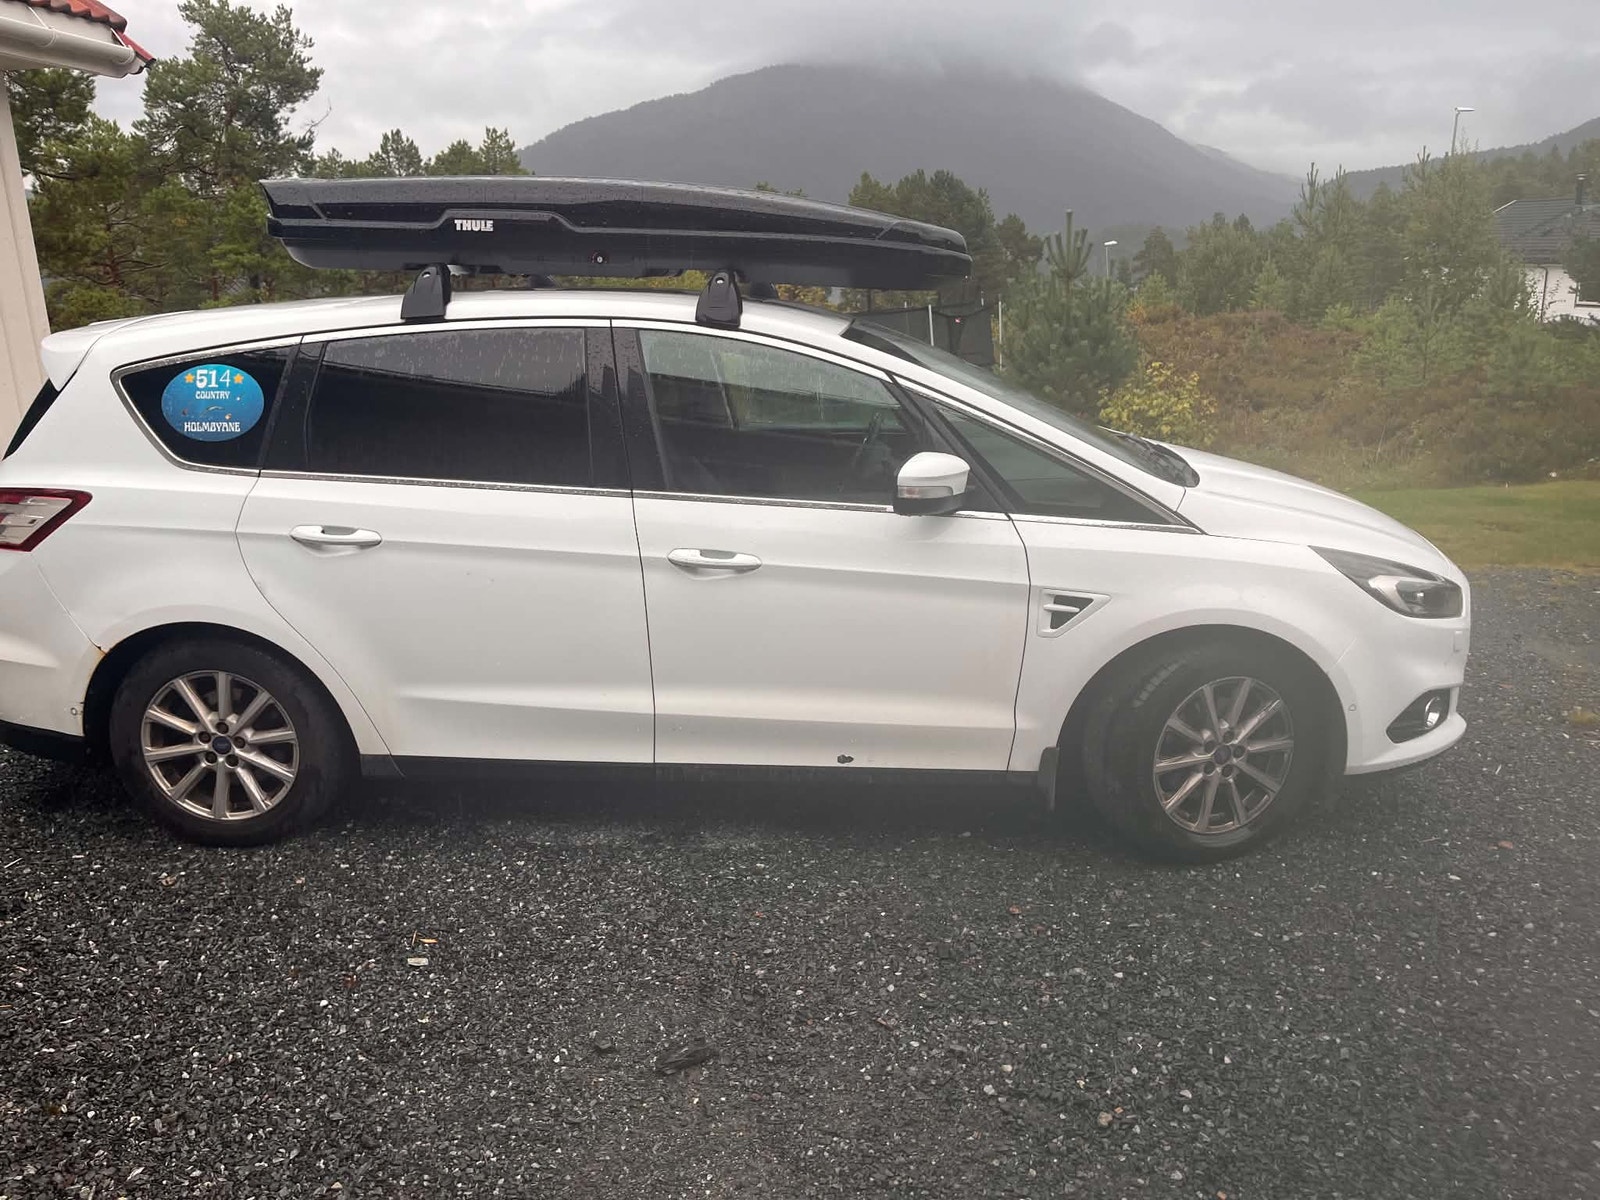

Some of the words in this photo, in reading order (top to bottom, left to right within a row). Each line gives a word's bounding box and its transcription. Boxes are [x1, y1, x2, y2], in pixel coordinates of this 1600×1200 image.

[454, 219, 494, 232] THULE
[195, 369, 231, 388] 514
[195, 391, 231, 400] COUNTRY
